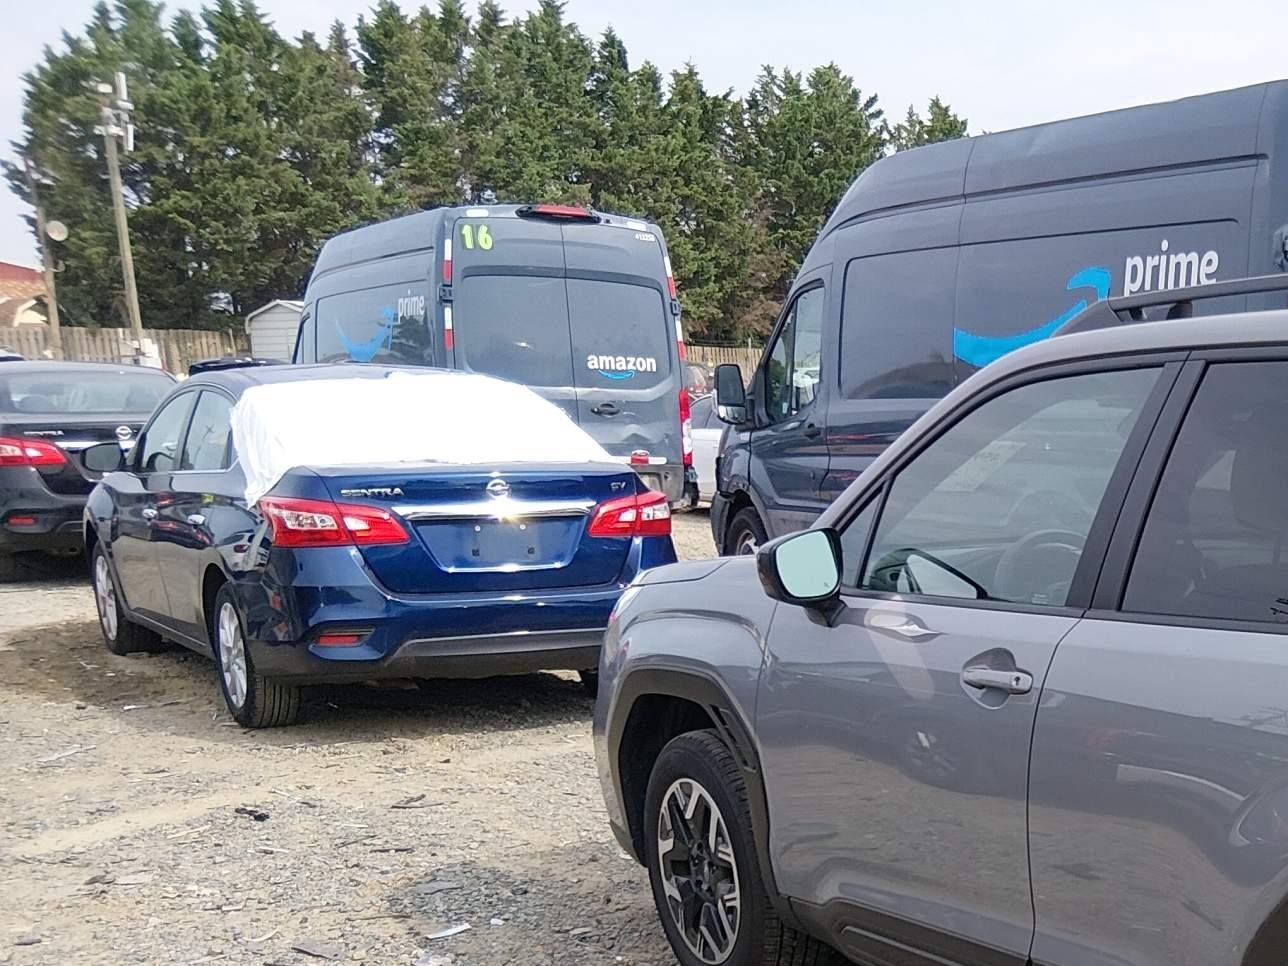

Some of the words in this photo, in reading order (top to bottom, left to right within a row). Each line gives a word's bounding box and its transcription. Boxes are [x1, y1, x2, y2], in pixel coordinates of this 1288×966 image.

[462, 224, 493, 250] 16
[1124, 239, 1219, 297] prime
[398, 289, 425, 324] prime
[587, 354, 657, 372] amazon
[340, 487, 405, 497] SENTRA
[610, 481, 627, 489] SV
